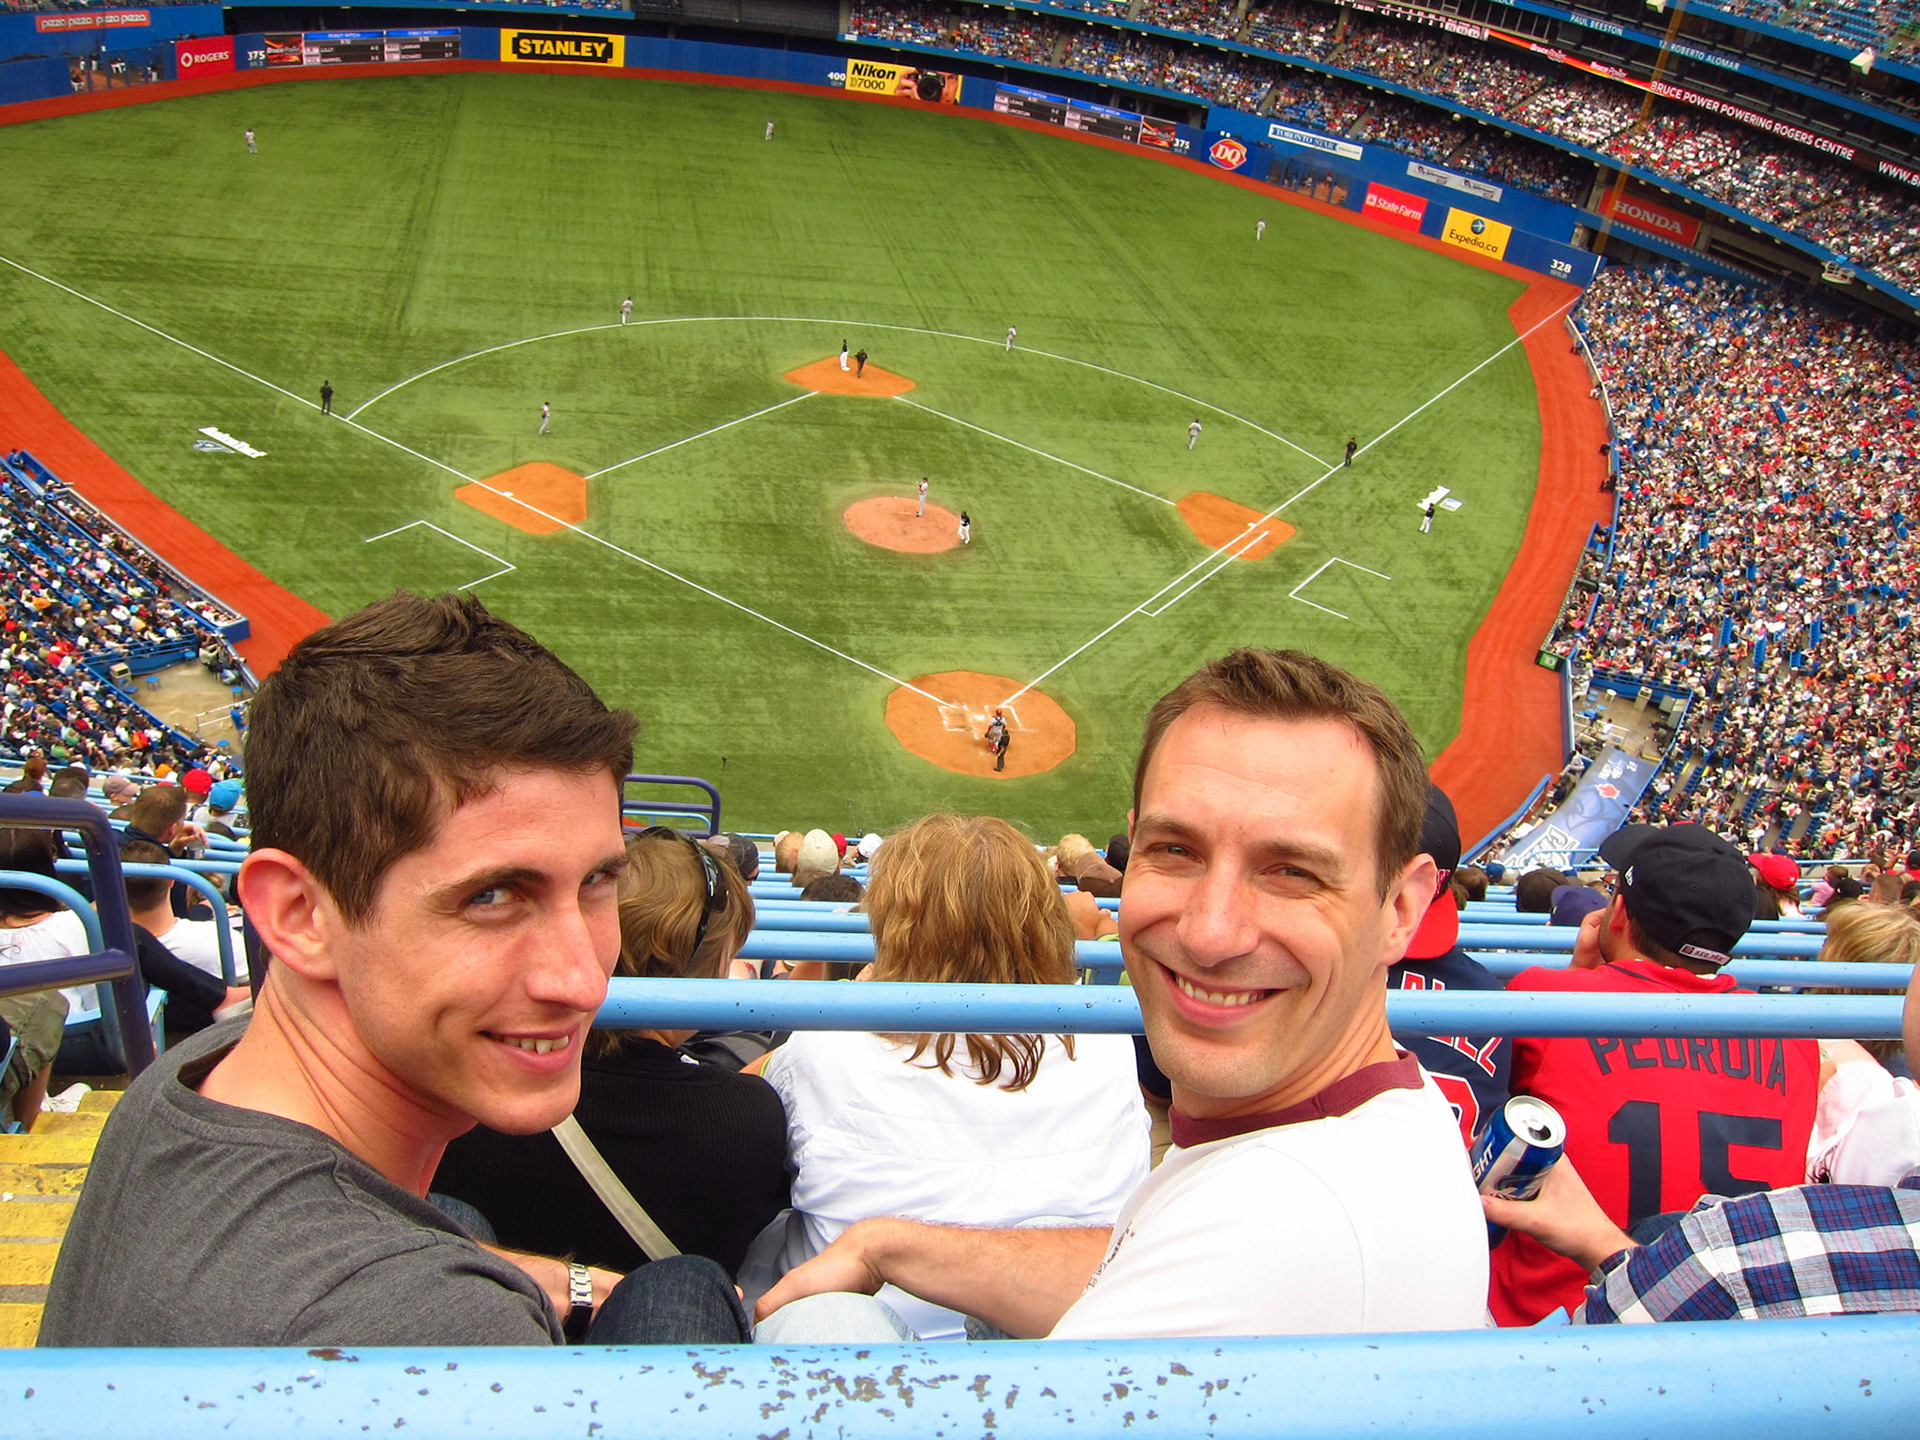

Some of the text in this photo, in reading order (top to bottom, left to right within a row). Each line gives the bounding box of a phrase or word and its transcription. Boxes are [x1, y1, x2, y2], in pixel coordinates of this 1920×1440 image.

[1570, 14, 1623, 36] PAUL BEESTON
[194, 51, 230, 64] ROGERS
[247, 50, 266, 61] 375
[518, 38, 607, 58] STANLEY
[1670, 44, 1705, 60] ROBERTO
[1705, 54, 1740, 70] ALOMAR
[827, 71, 846, 81] 400
[852, 62, 896, 80] Nikon
[850, 76, 886, 90] D7000
[1650, 80, 1682, 100] BRUCE
[1682, 92, 1720, 112] POWER
[1720, 104, 1772, 130] POWERING
[1772, 122, 1814, 146] ROGERS
[1814, 137, 1855, 161] CENTRE
[1173, 138, 1190, 150] 375
[1276, 128, 1334, 150] TORONTO STAR
[1216, 144, 1241, 166] DQ
[1377, 197, 1422, 220] State Farm
[1612, 200, 1683, 235] HONDA
[1449, 228, 1498, 253] Expedia.ca
[1550, 258, 1573, 274] 328
[1472, 1142, 1494, 1182] GHT
[1608, 1100, 1782, 1228] 15
